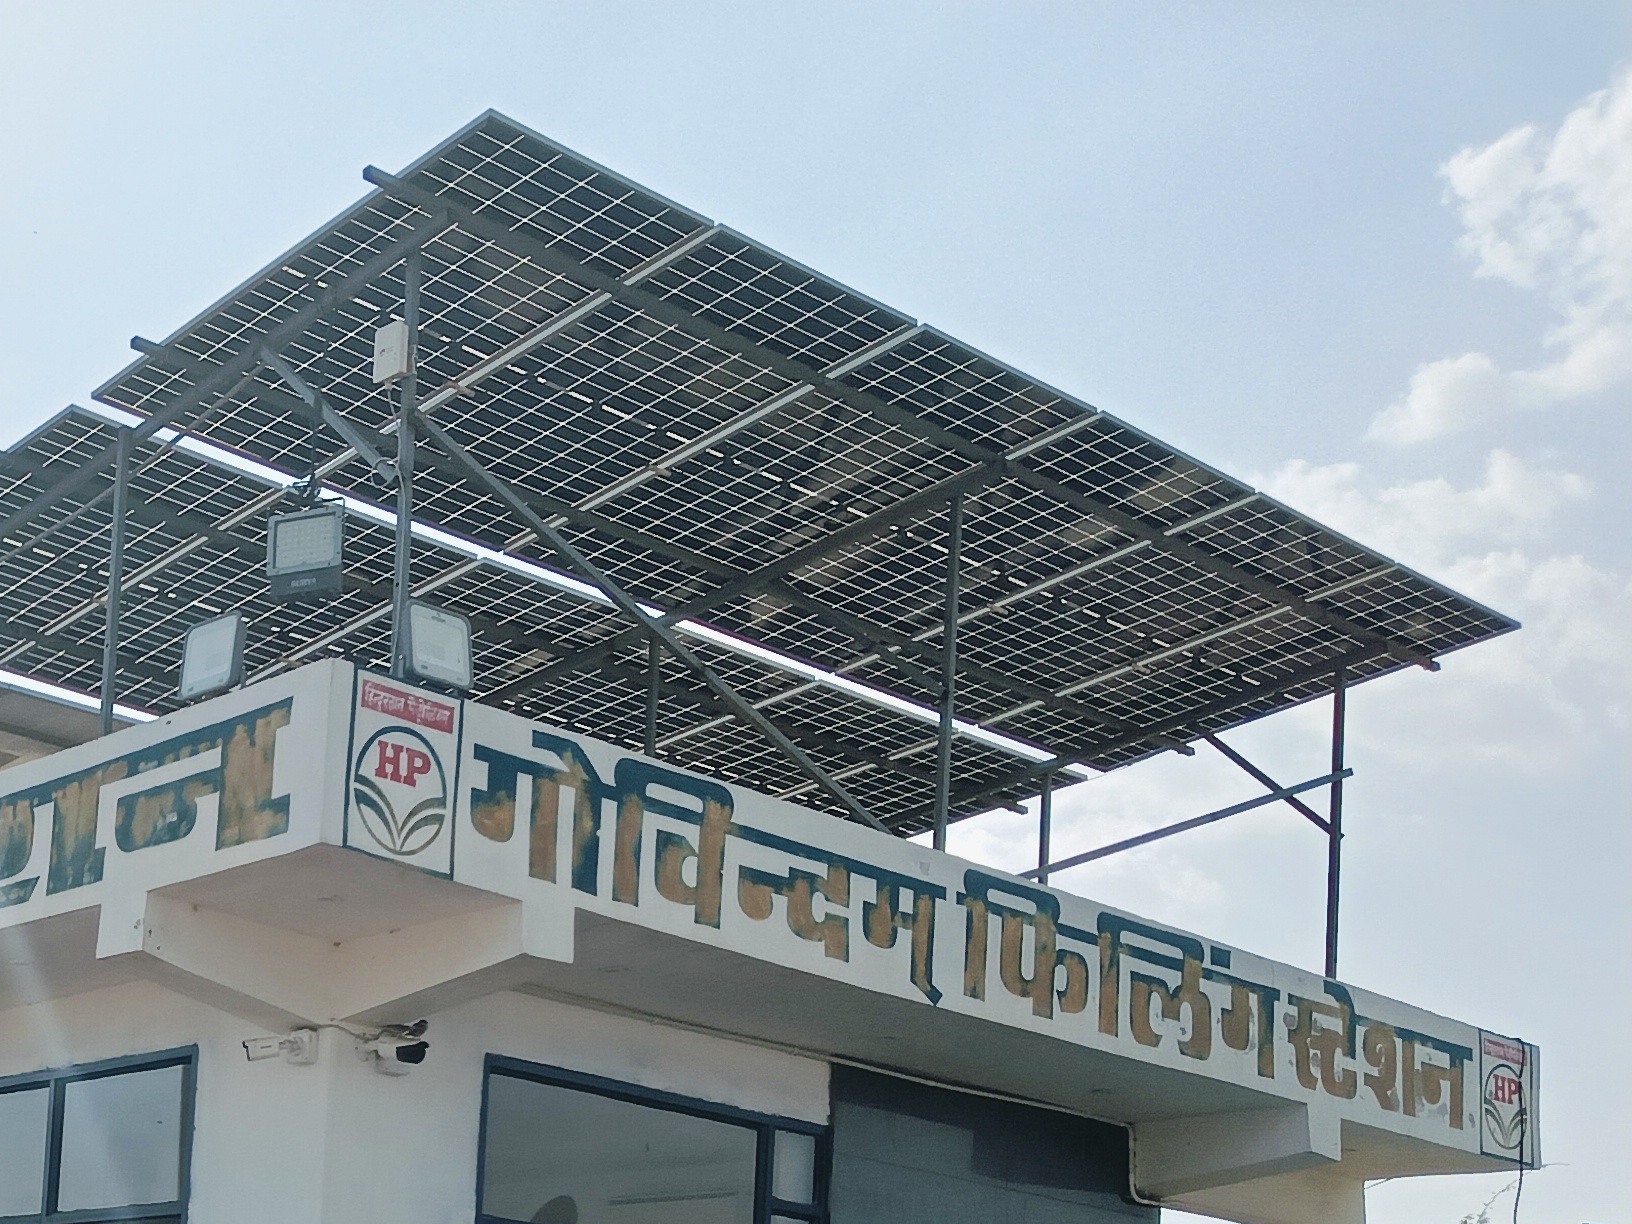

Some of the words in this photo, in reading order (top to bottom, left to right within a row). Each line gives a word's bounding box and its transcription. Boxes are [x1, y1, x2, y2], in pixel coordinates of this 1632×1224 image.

[374, 739, 432, 788] HP
[956, 868, 1281, 1079] फिलिंग
[1283, 980, 1474, 1130] स्टेशन
[1492, 1073, 1522, 1105] HP
